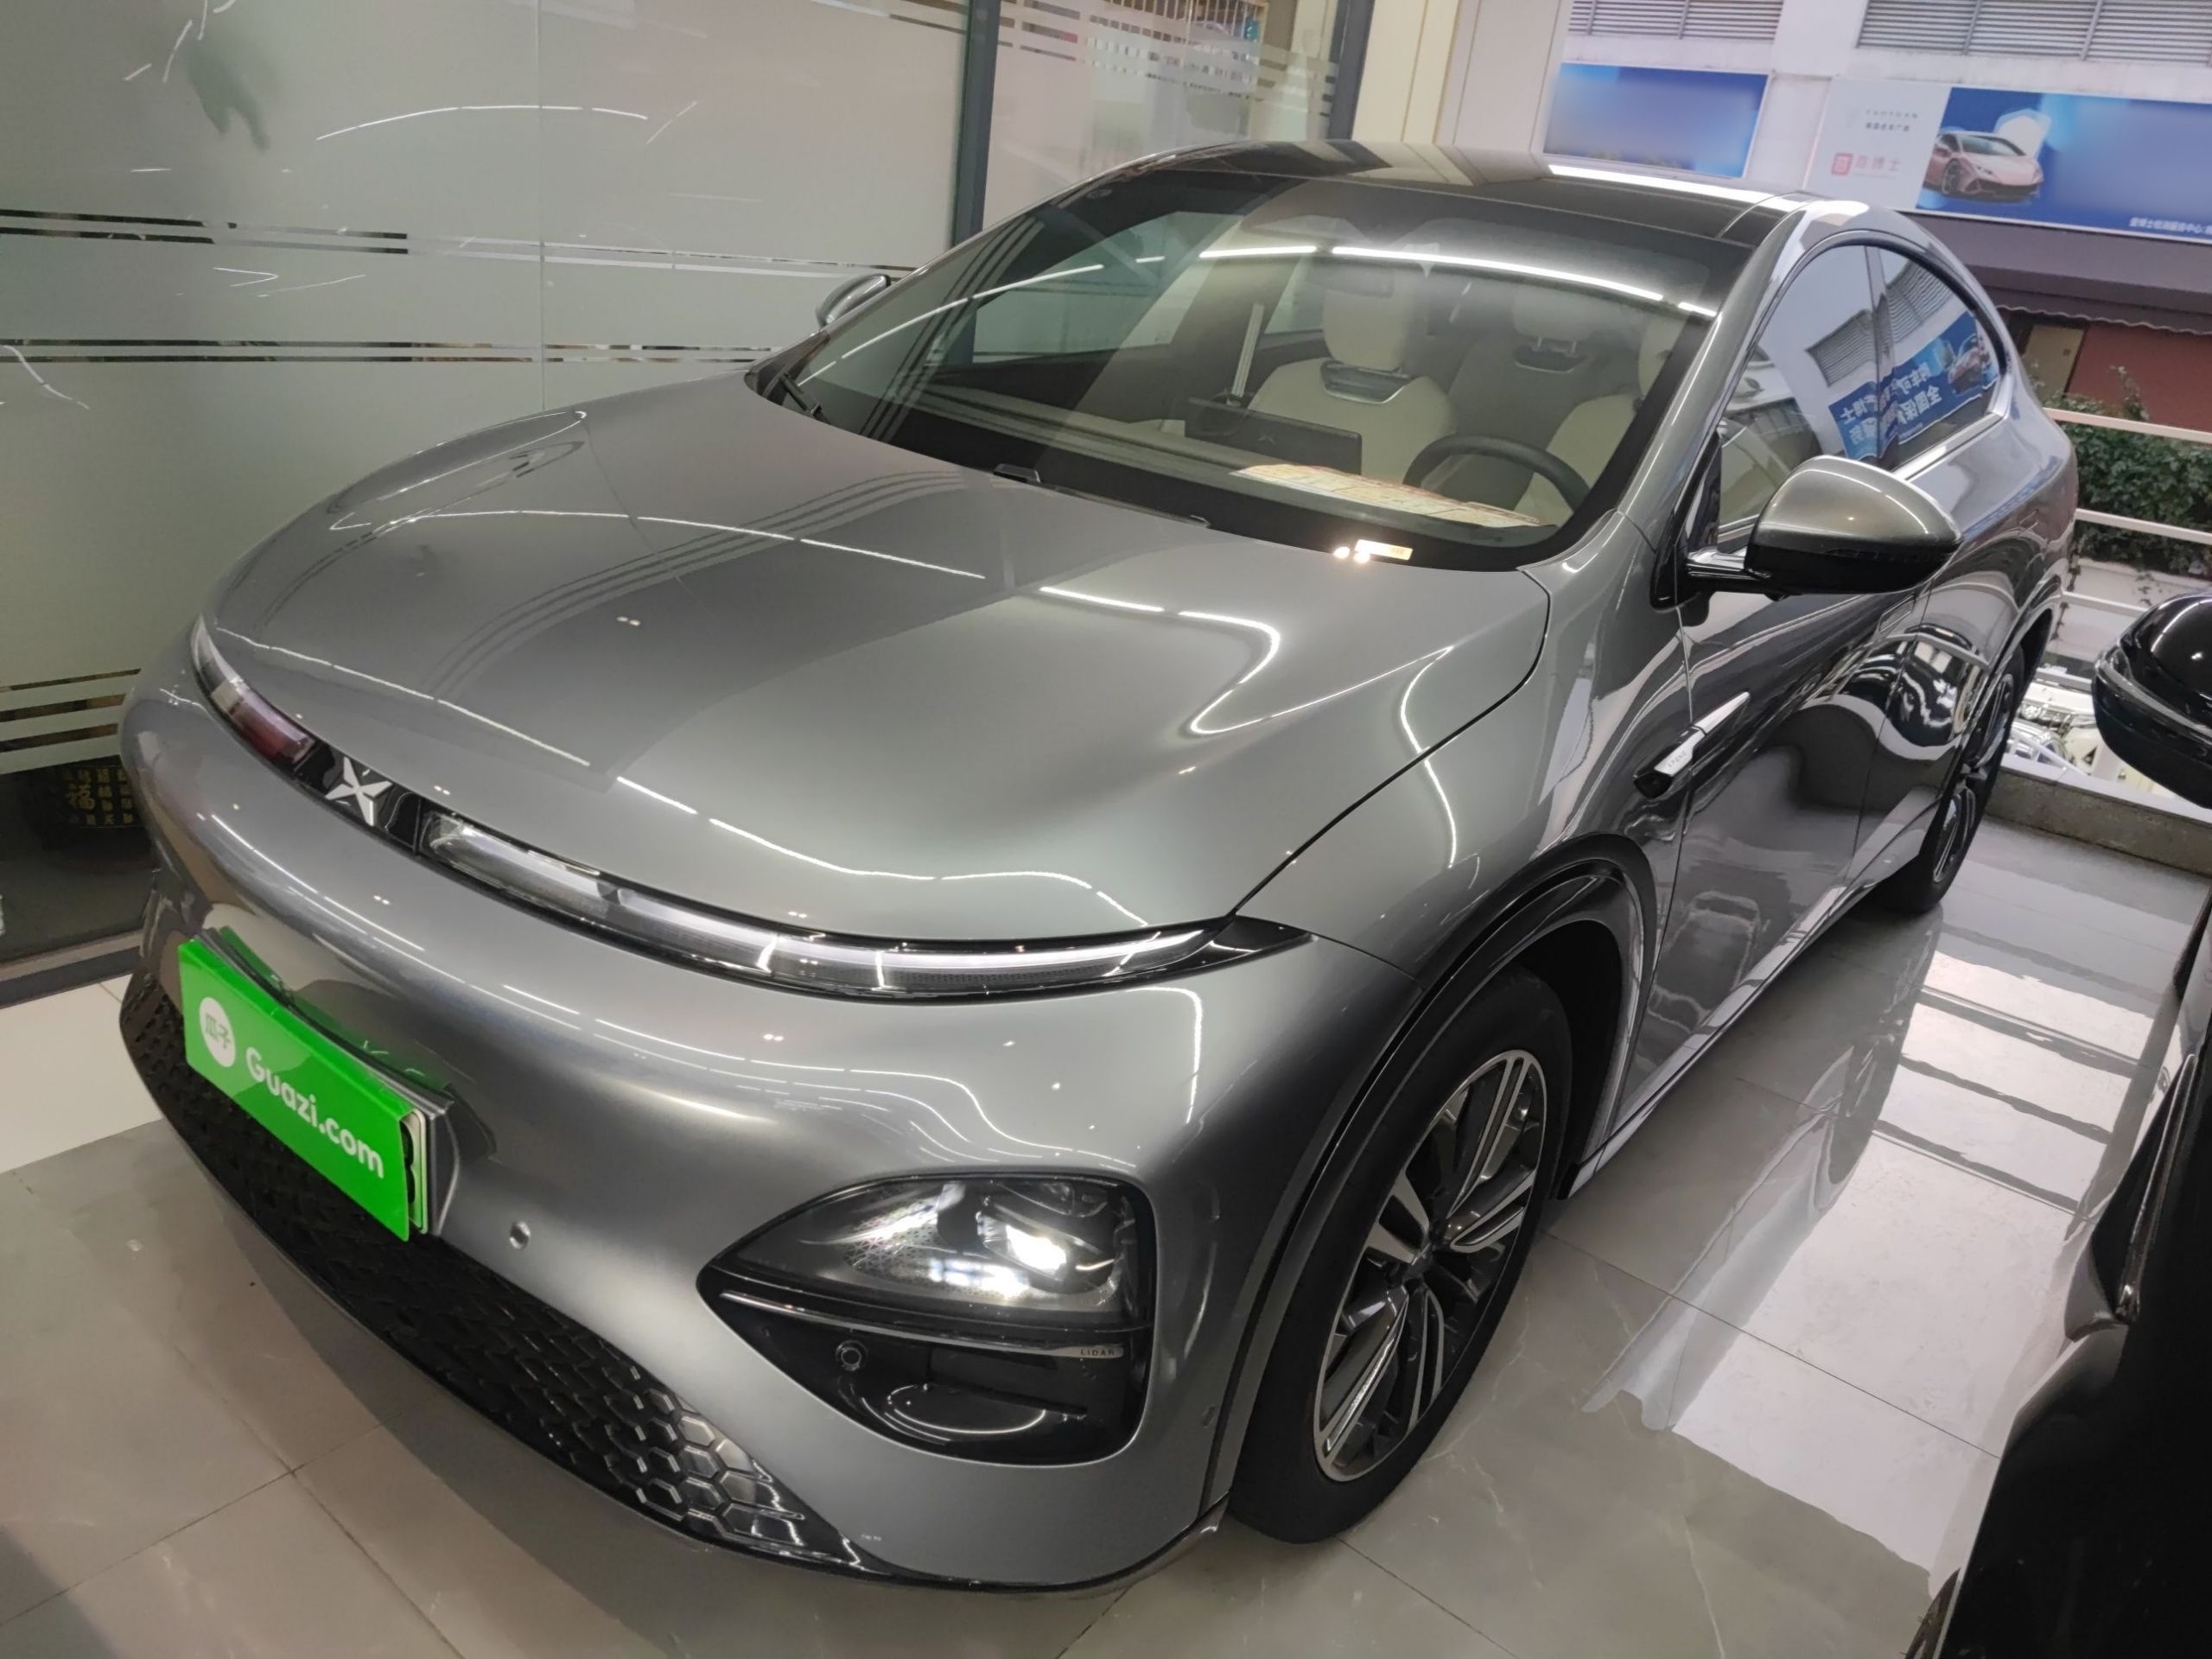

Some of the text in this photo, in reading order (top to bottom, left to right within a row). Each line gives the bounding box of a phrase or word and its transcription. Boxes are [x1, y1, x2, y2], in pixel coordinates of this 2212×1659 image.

[205, 1012, 232, 1050] 瓜子
[245, 1046, 385, 1179] Guazi.com
[1080, 1348, 1115, 1357] LIDAR
